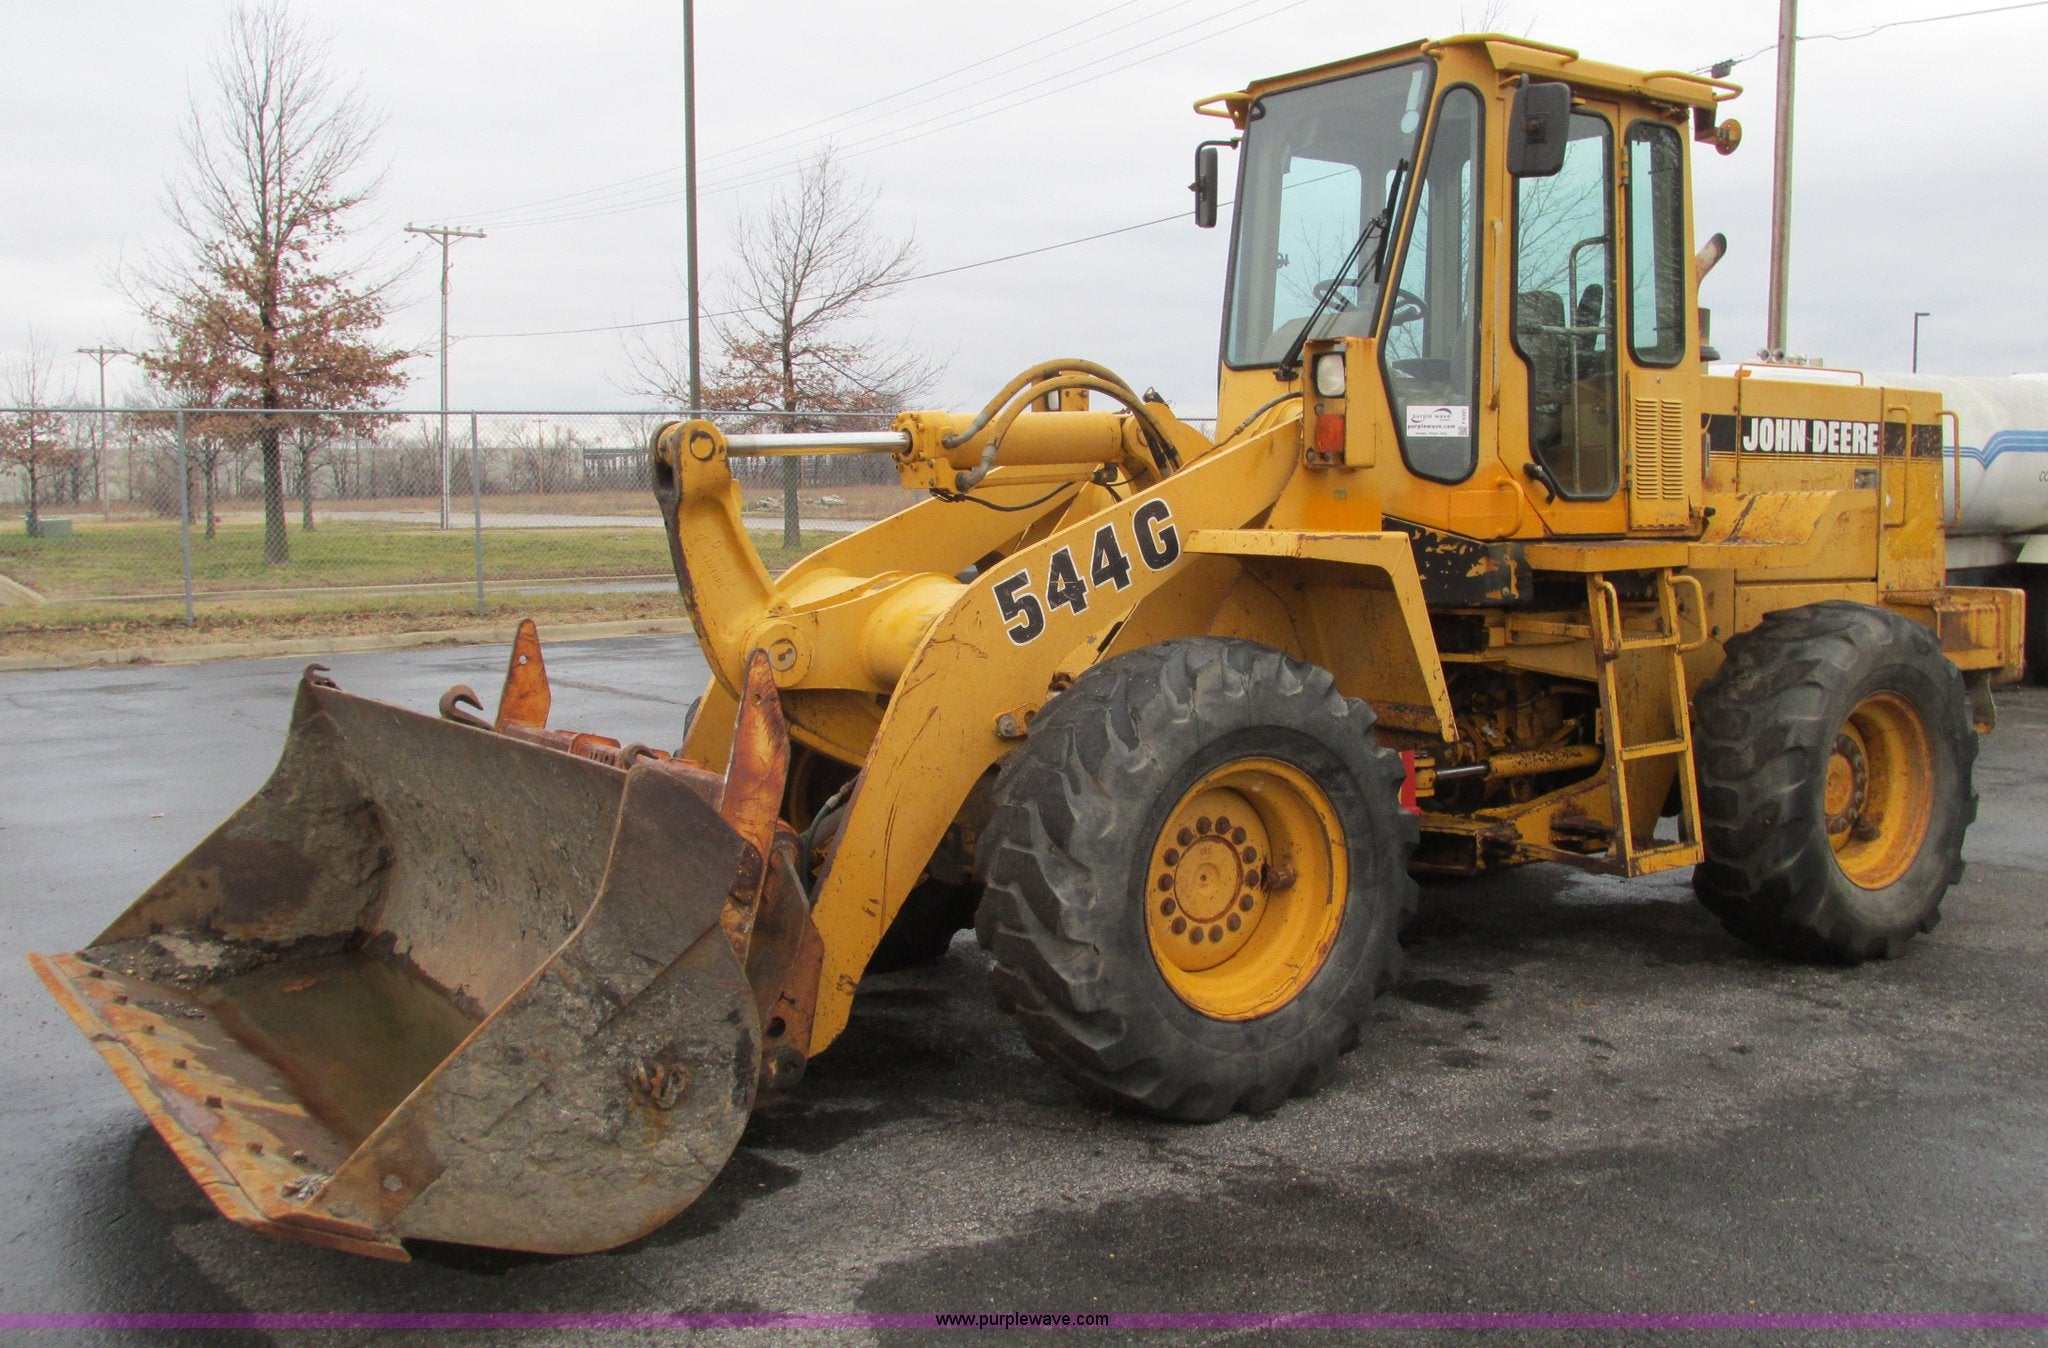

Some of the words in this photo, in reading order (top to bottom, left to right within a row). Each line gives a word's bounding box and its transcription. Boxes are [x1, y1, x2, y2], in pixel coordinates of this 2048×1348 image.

[1742, 417, 1806, 452] JOHN
[1812, 420, 1879, 455] DEERE
[992, 497, 1181, 646] 544G
